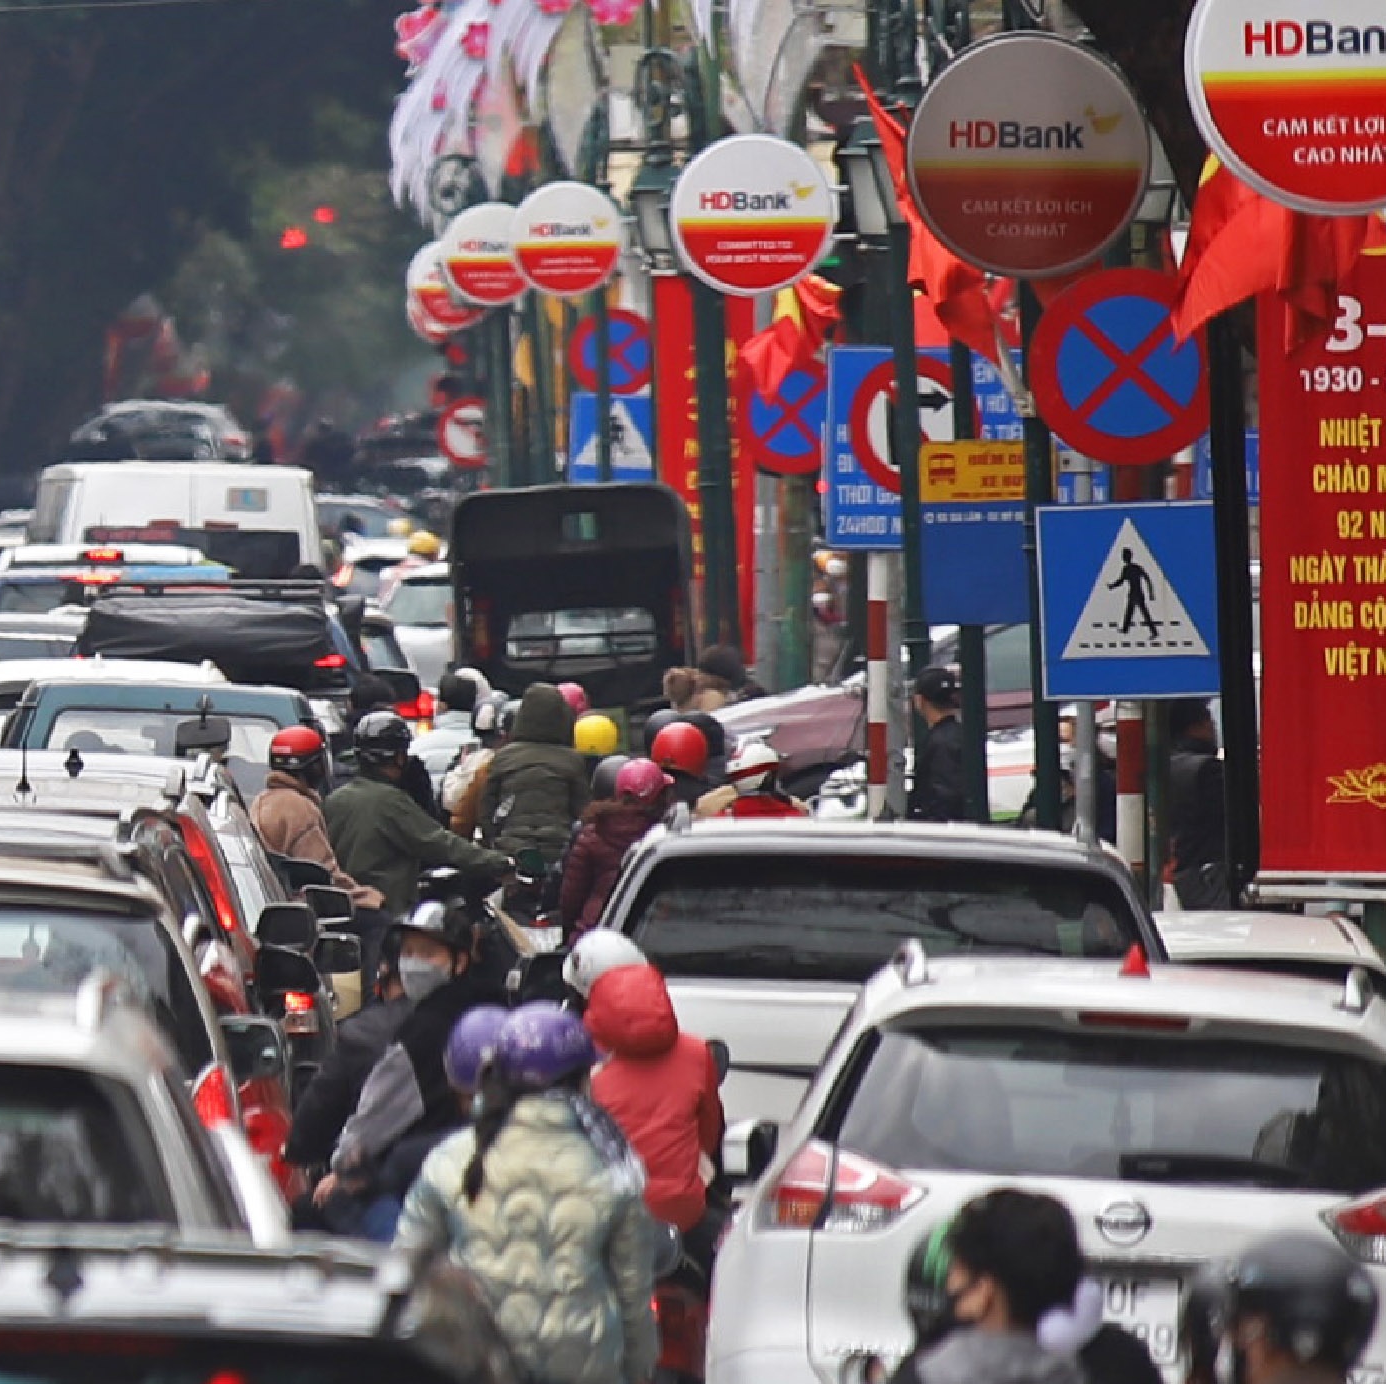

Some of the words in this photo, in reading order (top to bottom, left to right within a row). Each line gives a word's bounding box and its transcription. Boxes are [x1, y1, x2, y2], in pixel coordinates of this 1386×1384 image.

[949, 120, 1084, 149] HDBank
[1263, 118, 1308, 137] CAM
[1313, 112, 1349, 137] KẾT
[1354, 116, 1385, 139] LỢI
[1293, 146, 1336, 164] CAO
[699, 191, 791, 211] HDBank
[962, 199, 999, 215] CAM
[986, 223, 1022, 237] CAO
[1299, 365, 1363, 392] 1930
[1319, 413, 1382, 453] NHIỆT
[1313, 457, 1370, 493] CHÀO
[1337, 511, 1364, 539] 92
[1290, 549, 1346, 584] NGÀY
[1294, 590, 1354, 629] ĐẢNG
[1324, 641, 1370, 681] VIỆT
[1106, 1278, 1151, 1316] 0F
